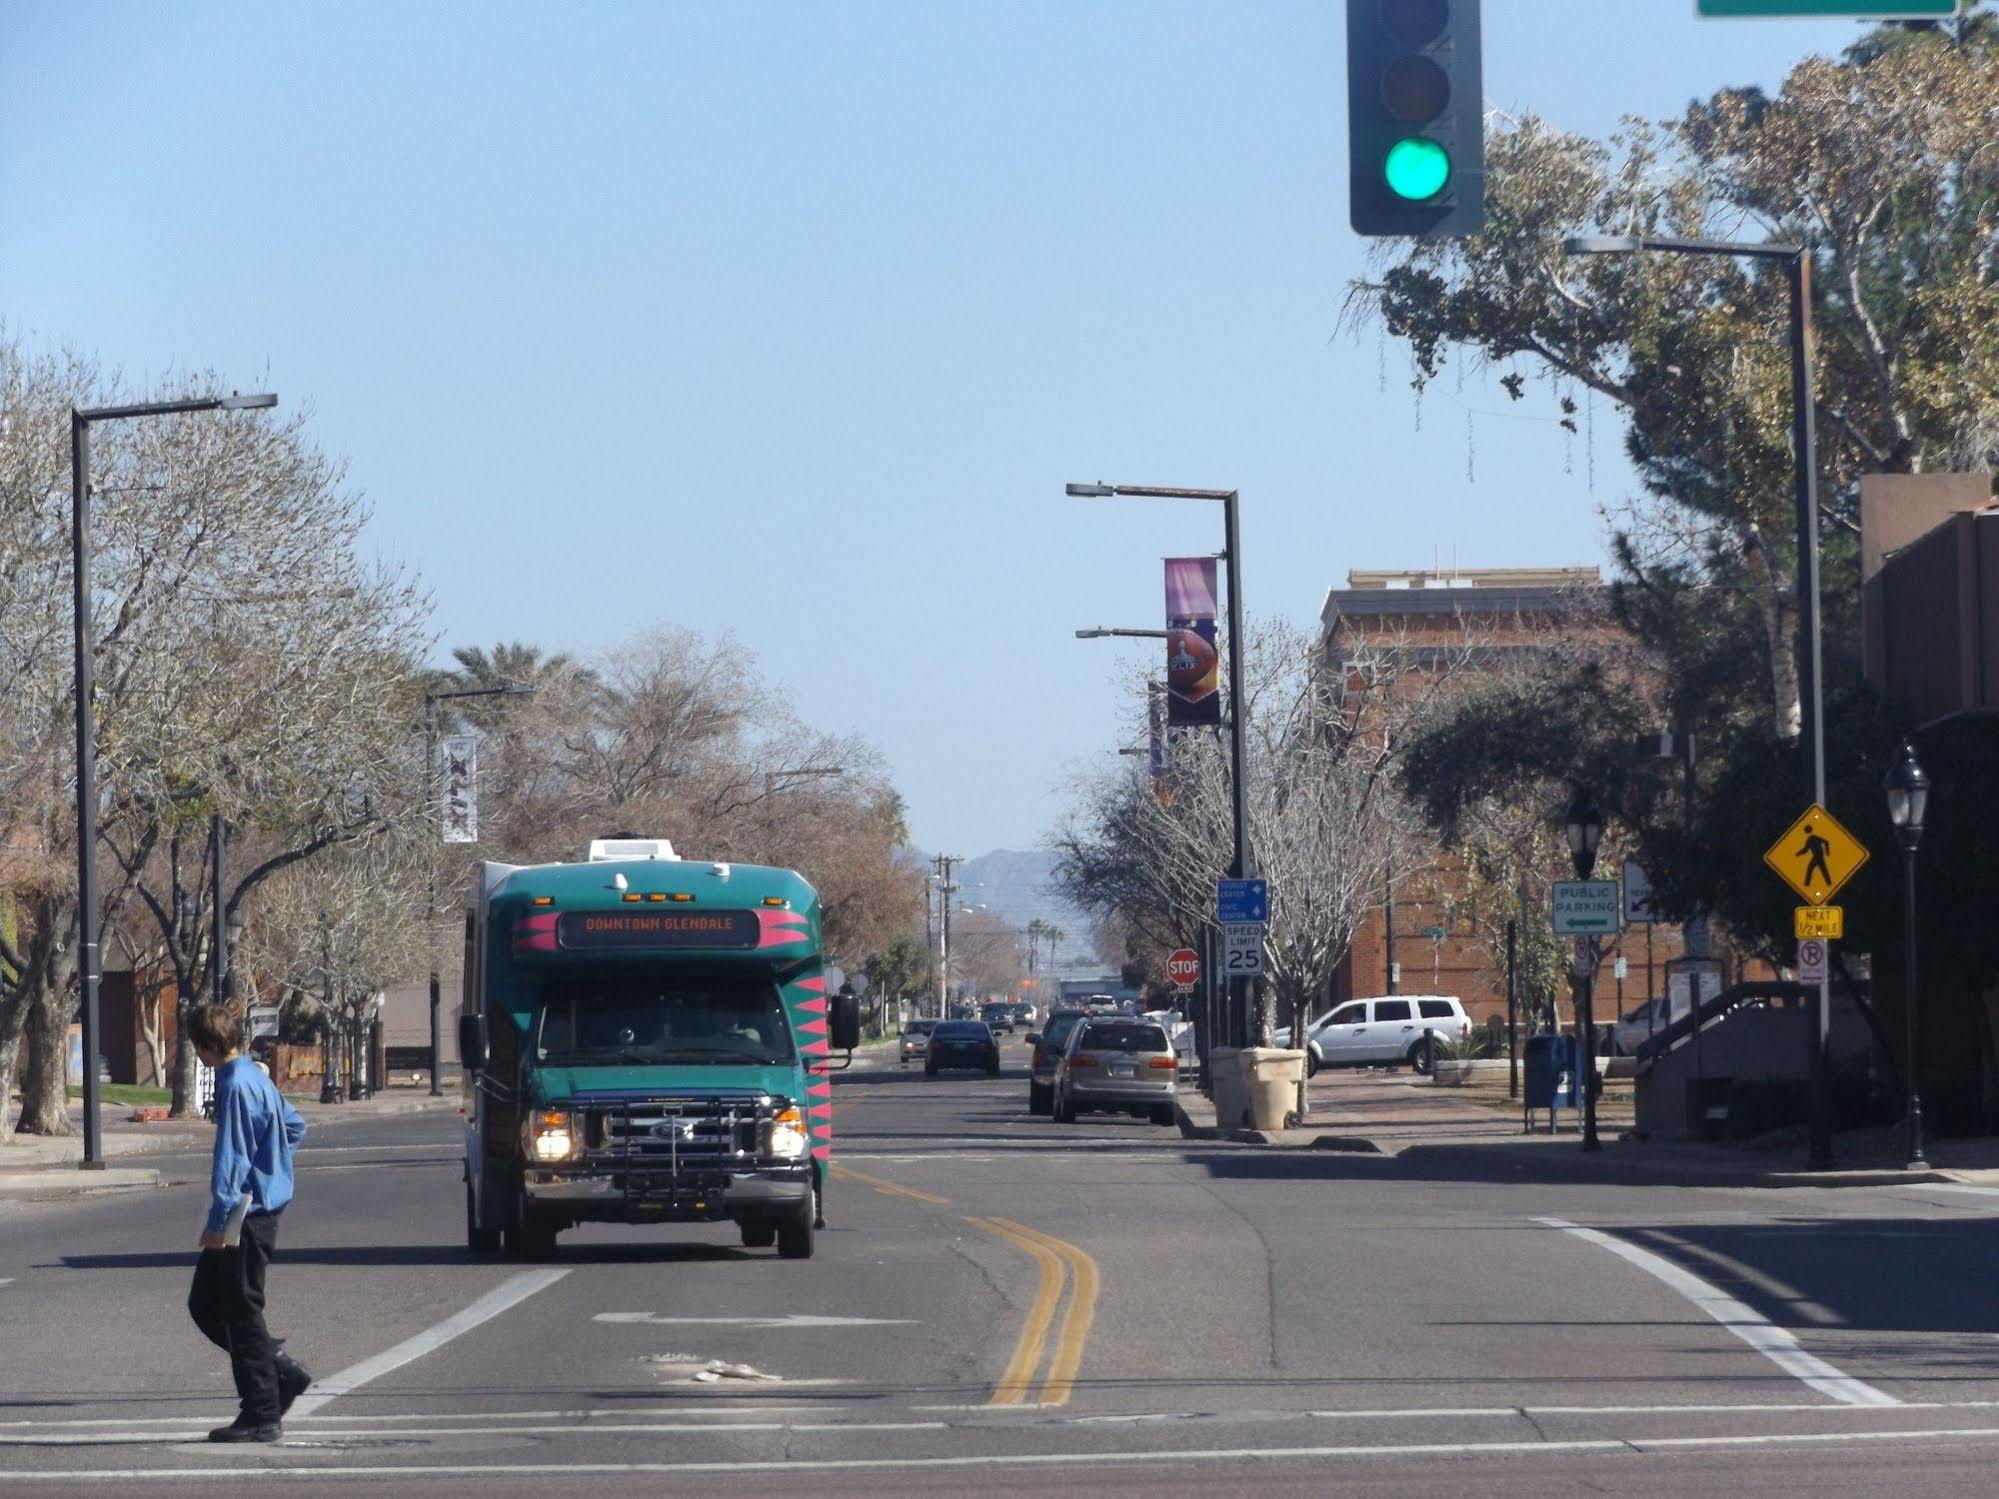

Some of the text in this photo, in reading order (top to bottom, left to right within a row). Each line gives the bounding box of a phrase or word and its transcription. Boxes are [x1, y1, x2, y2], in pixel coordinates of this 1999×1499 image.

[1560, 887, 1609, 898] PUBLIC
[1555, 902, 1616, 912] PARKING
[1806, 910, 1831, 920] NEXT
[586, 917, 733, 930] DOWNTOWN GLENDALE
[1816, 923, 1838, 934] MILE
[1227, 927, 1259, 936] SPEED
[1230, 938, 1256, 946] LIMIT
[1228, 950, 1260, 969] 25
[1169, 960, 1200, 974] STOP
